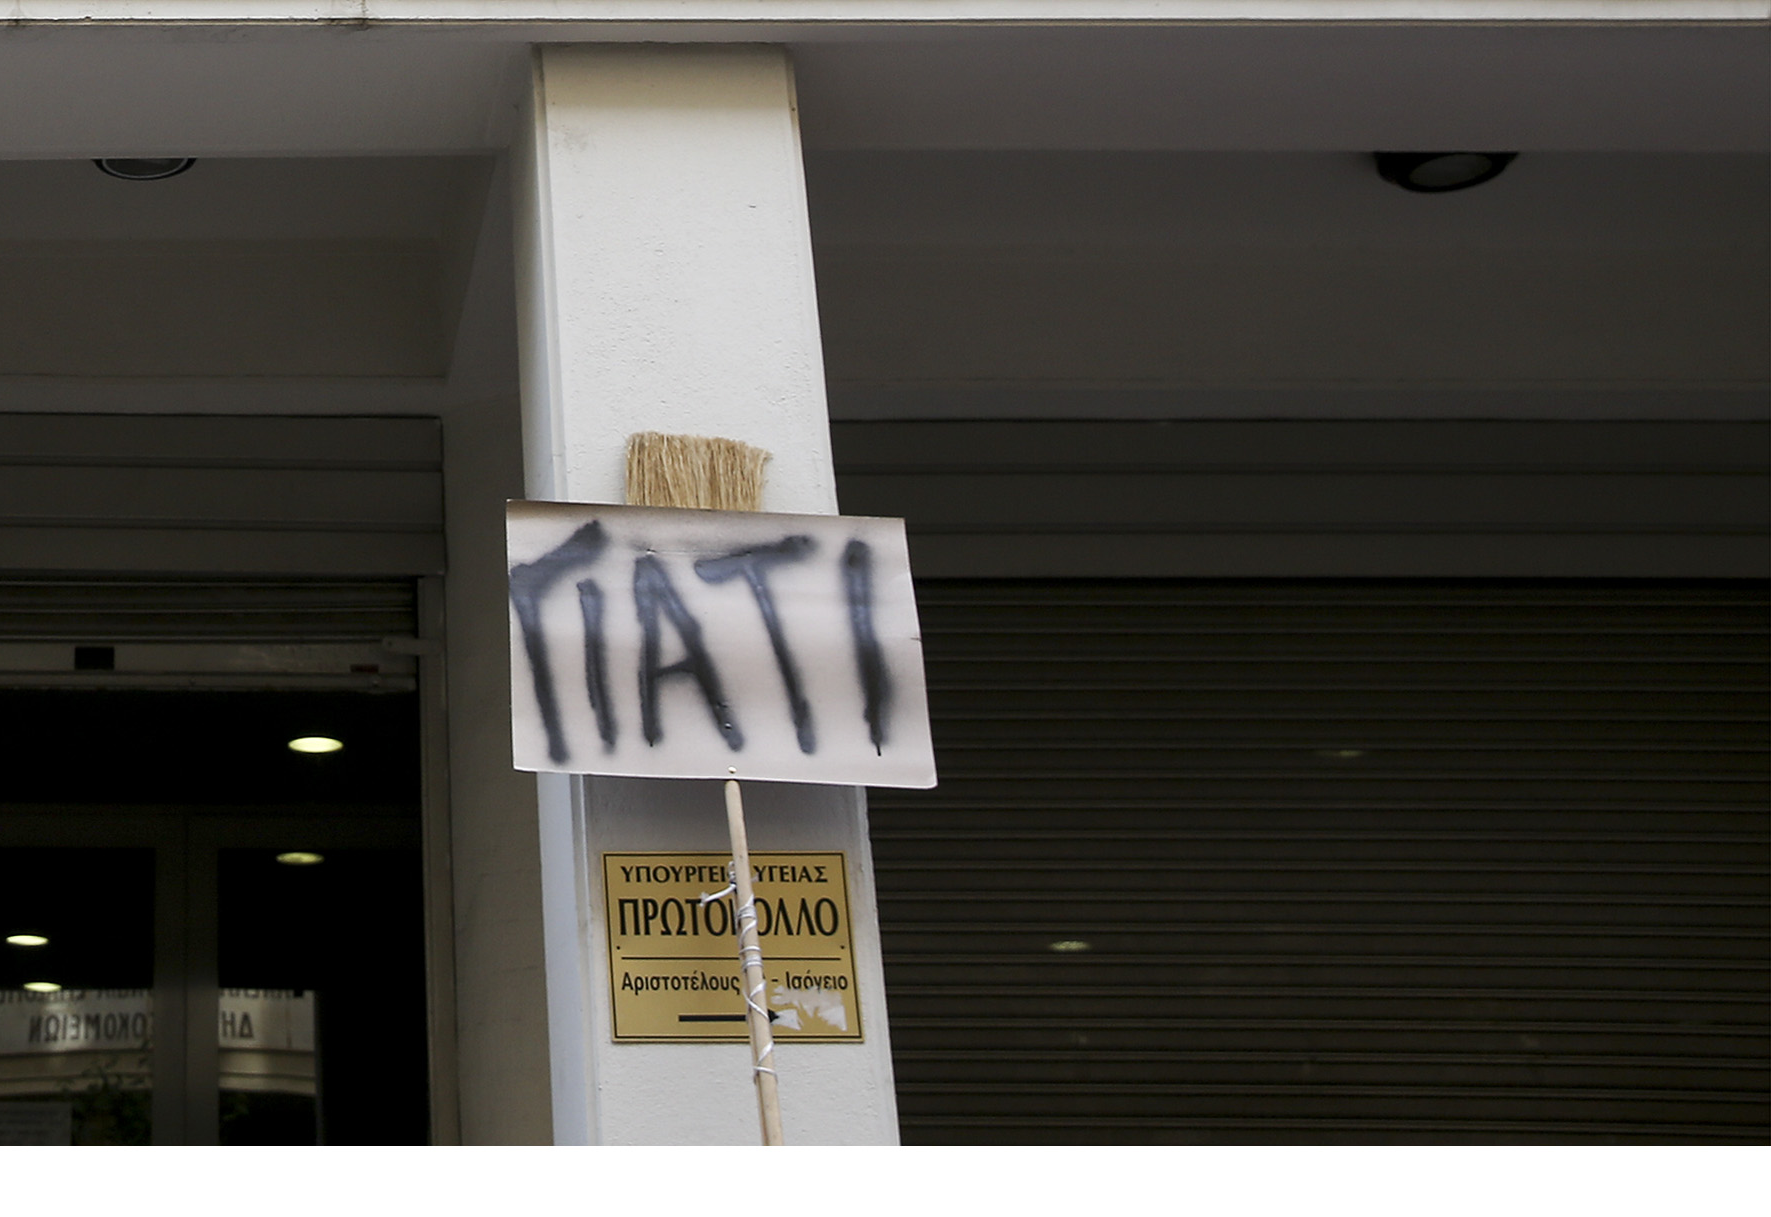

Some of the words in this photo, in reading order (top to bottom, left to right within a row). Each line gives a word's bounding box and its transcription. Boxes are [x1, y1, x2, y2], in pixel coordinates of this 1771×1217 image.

[509, 519, 896, 764] ΓΙΑΤΙ
[621, 865, 732, 883] ΥΠΟΥΡΓΕΙ
[753, 865, 828, 883] ΥΓΕΙΑΣ
[618, 897, 839, 936] ΠΡΩΤΟΟΛΛΟ
[621, 971, 740, 995] Αριστοτέλους
[786, 970, 848, 994] Ισόγειο
